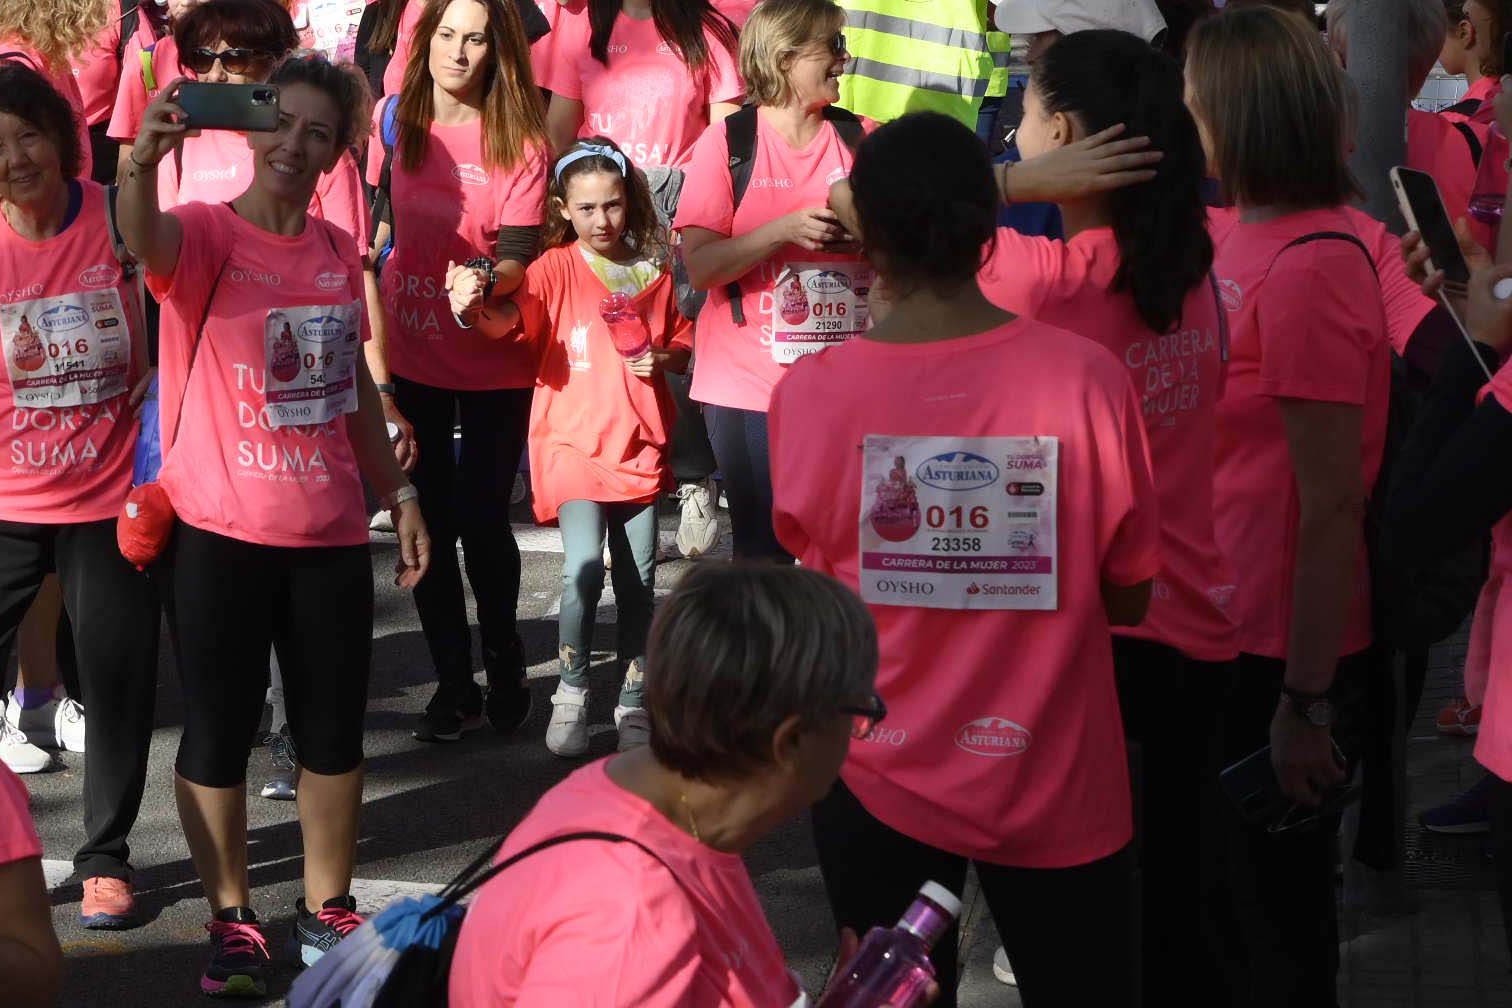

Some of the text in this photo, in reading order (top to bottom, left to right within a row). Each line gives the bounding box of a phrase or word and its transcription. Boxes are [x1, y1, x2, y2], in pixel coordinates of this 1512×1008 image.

[812, 302, 847, 317] 016
[815, 320, 843, 330] 21290
[47, 338, 89, 359] 016
[1126, 326, 1215, 368] CARRERA
[1146, 363, 1172, 392] DE
[1143, 389, 1200, 415] MUJER
[277, 407, 312, 418] OYSHO
[10, 438, 98, 467] SUMA
[238, 441, 328, 472] SUMA
[924, 465, 993, 481] ASTURIANA
[1006, 460, 1043, 470] SUMA
[926, 505, 990, 530] 016
[931, 537, 982, 552] 23358
[881, 557, 1037, 570] CARRERA DE LA MUJER 2023
[876, 580, 1041, 596] OYSHO Santander
[960, 728, 1026, 749] ASTURIANA
